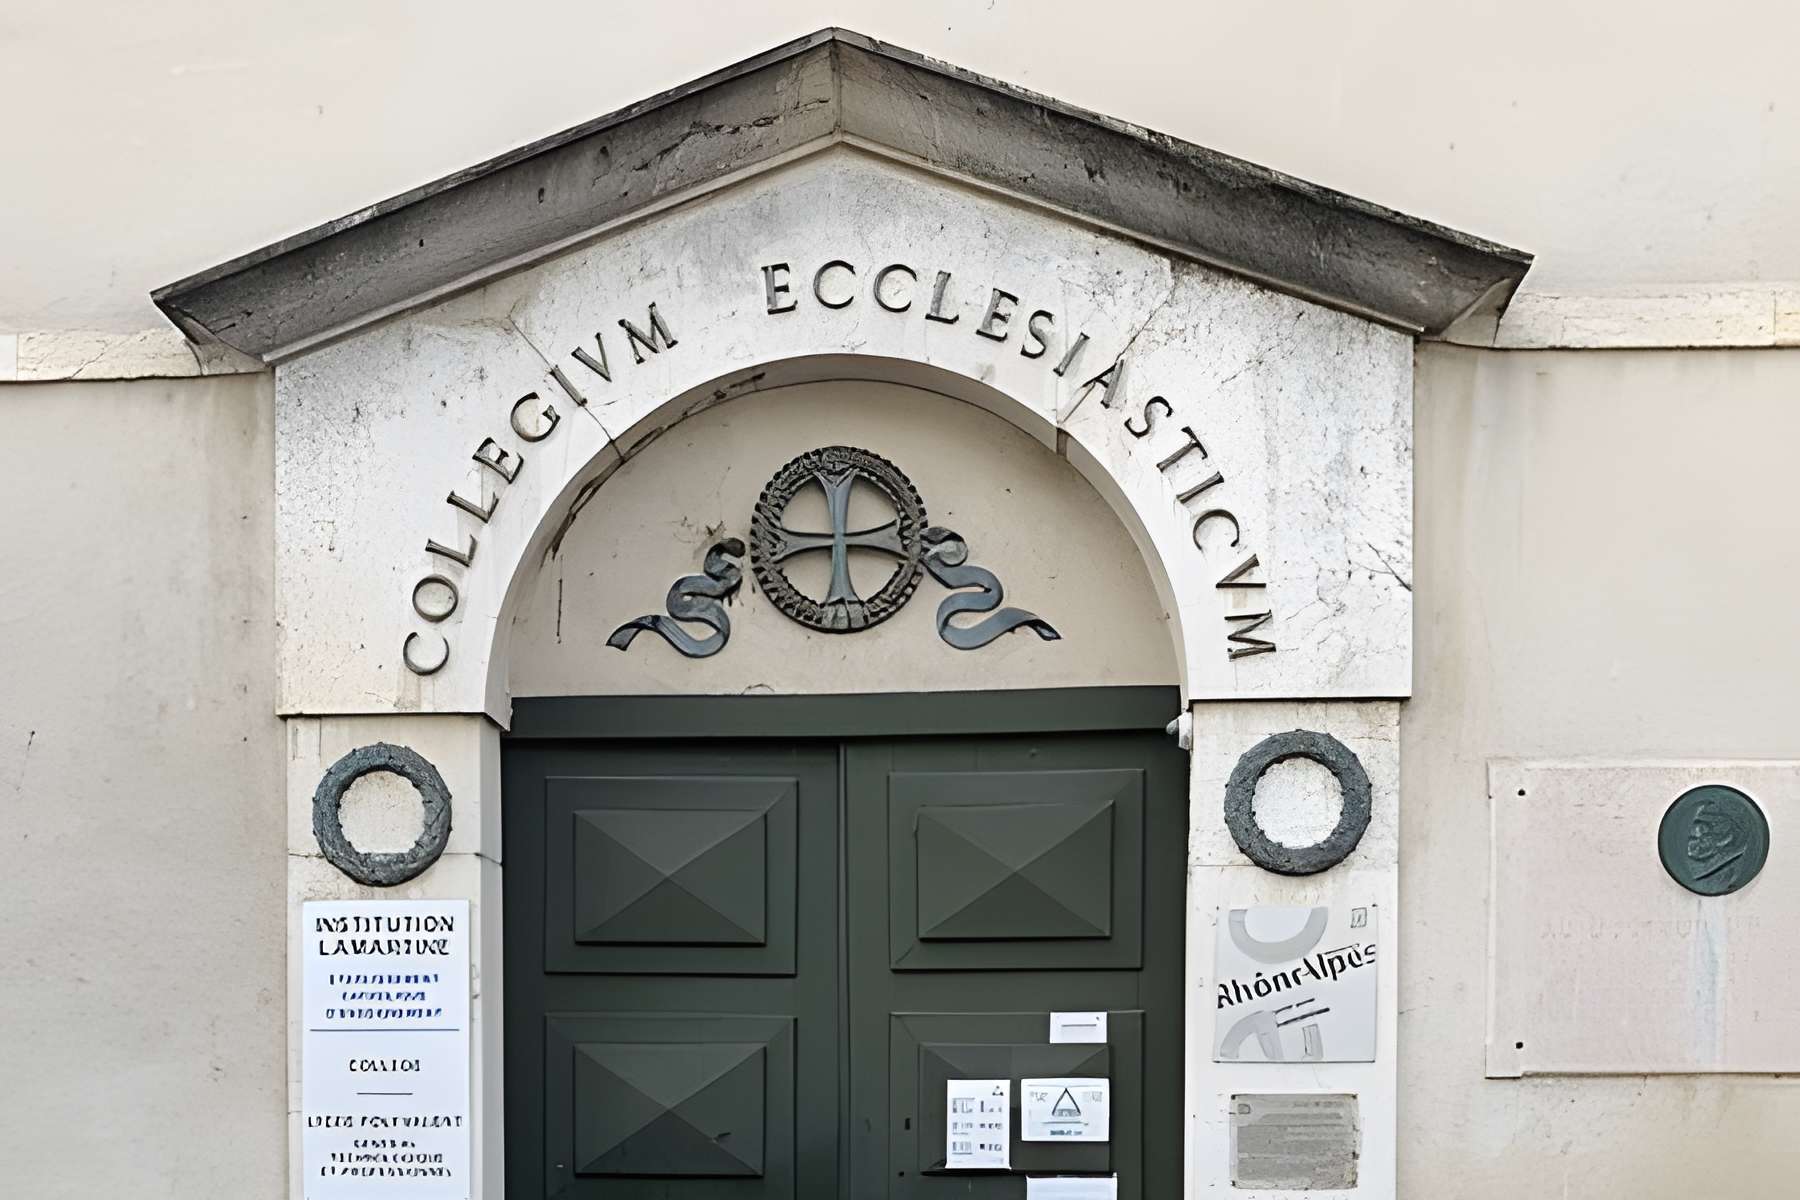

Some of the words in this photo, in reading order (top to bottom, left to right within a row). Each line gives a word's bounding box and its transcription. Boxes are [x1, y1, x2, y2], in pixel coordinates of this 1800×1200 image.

[402, 302, 678, 676] COLLEGIVM
[762, 259, 1278, 661] ECCLESIASTICVM
[316, 915, 455, 933] INSTITUTION
